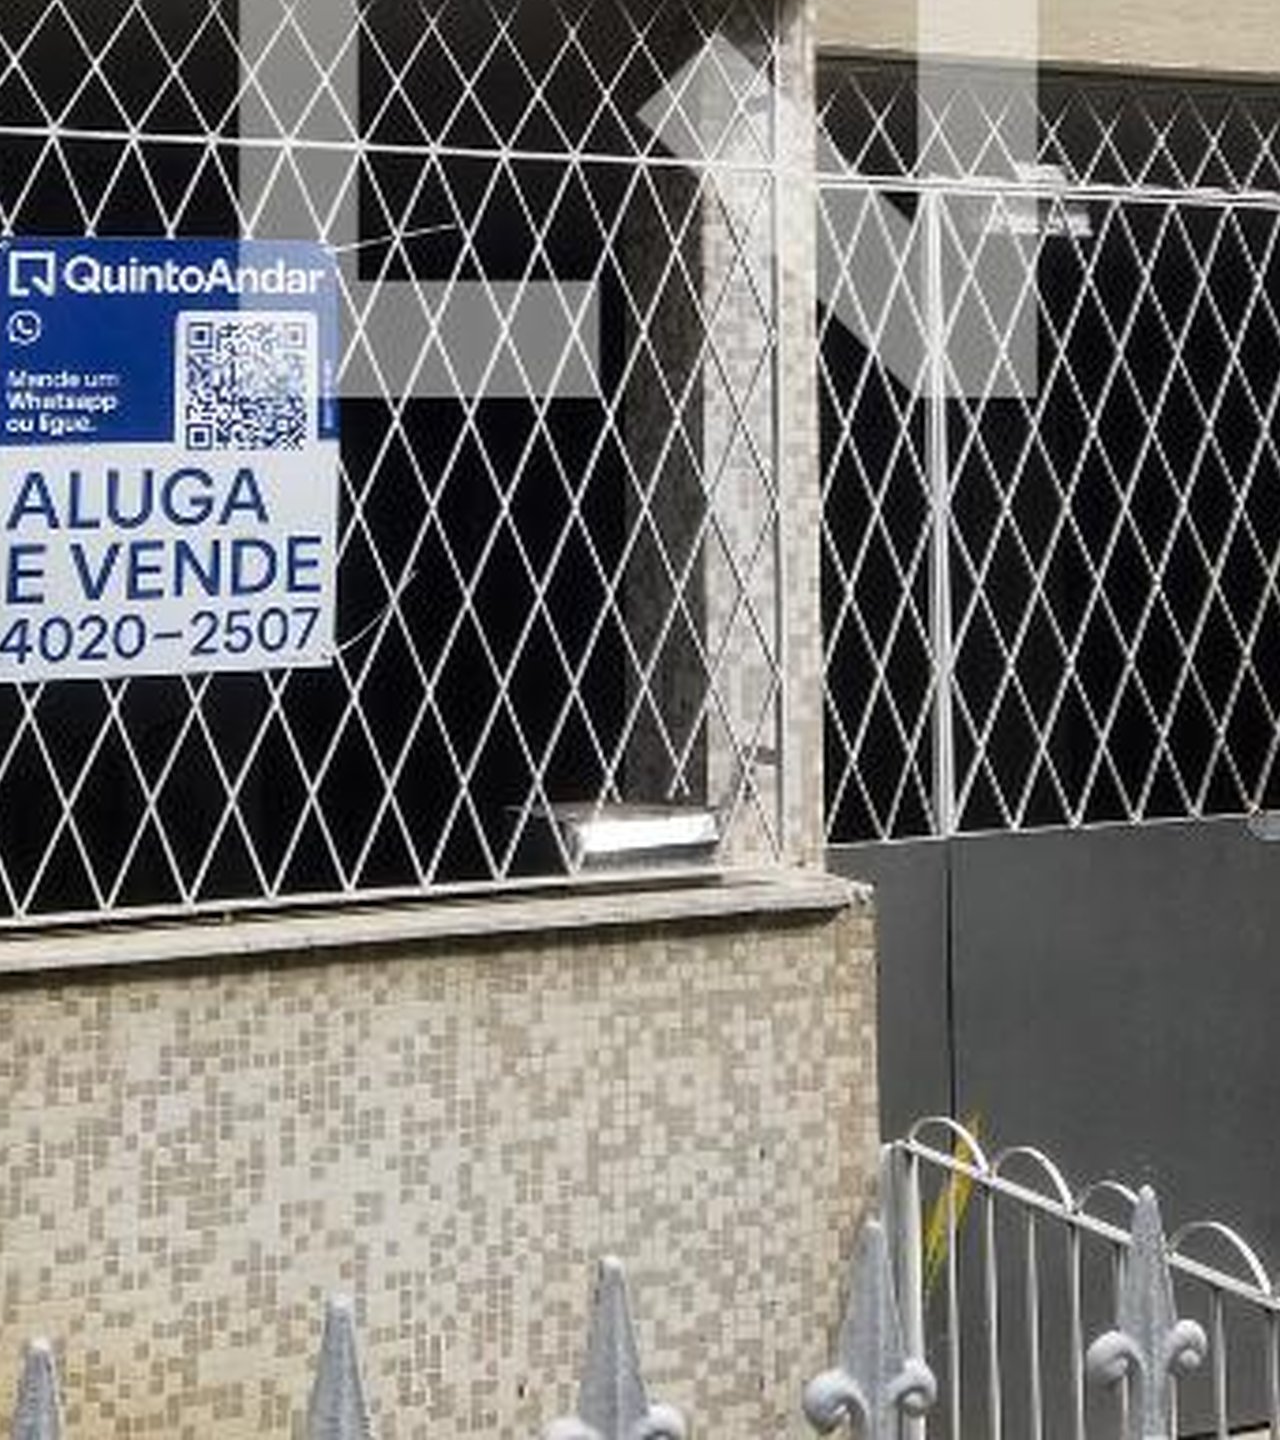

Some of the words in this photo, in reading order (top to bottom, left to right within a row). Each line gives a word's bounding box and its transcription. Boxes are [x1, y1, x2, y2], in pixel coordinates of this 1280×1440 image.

[63, 255, 326, 295] QuintoAndar
[5, 467, 270, 530] ALUGA
[5, 543, 47, 604] E
[69, 535, 323, 602] VENDE
